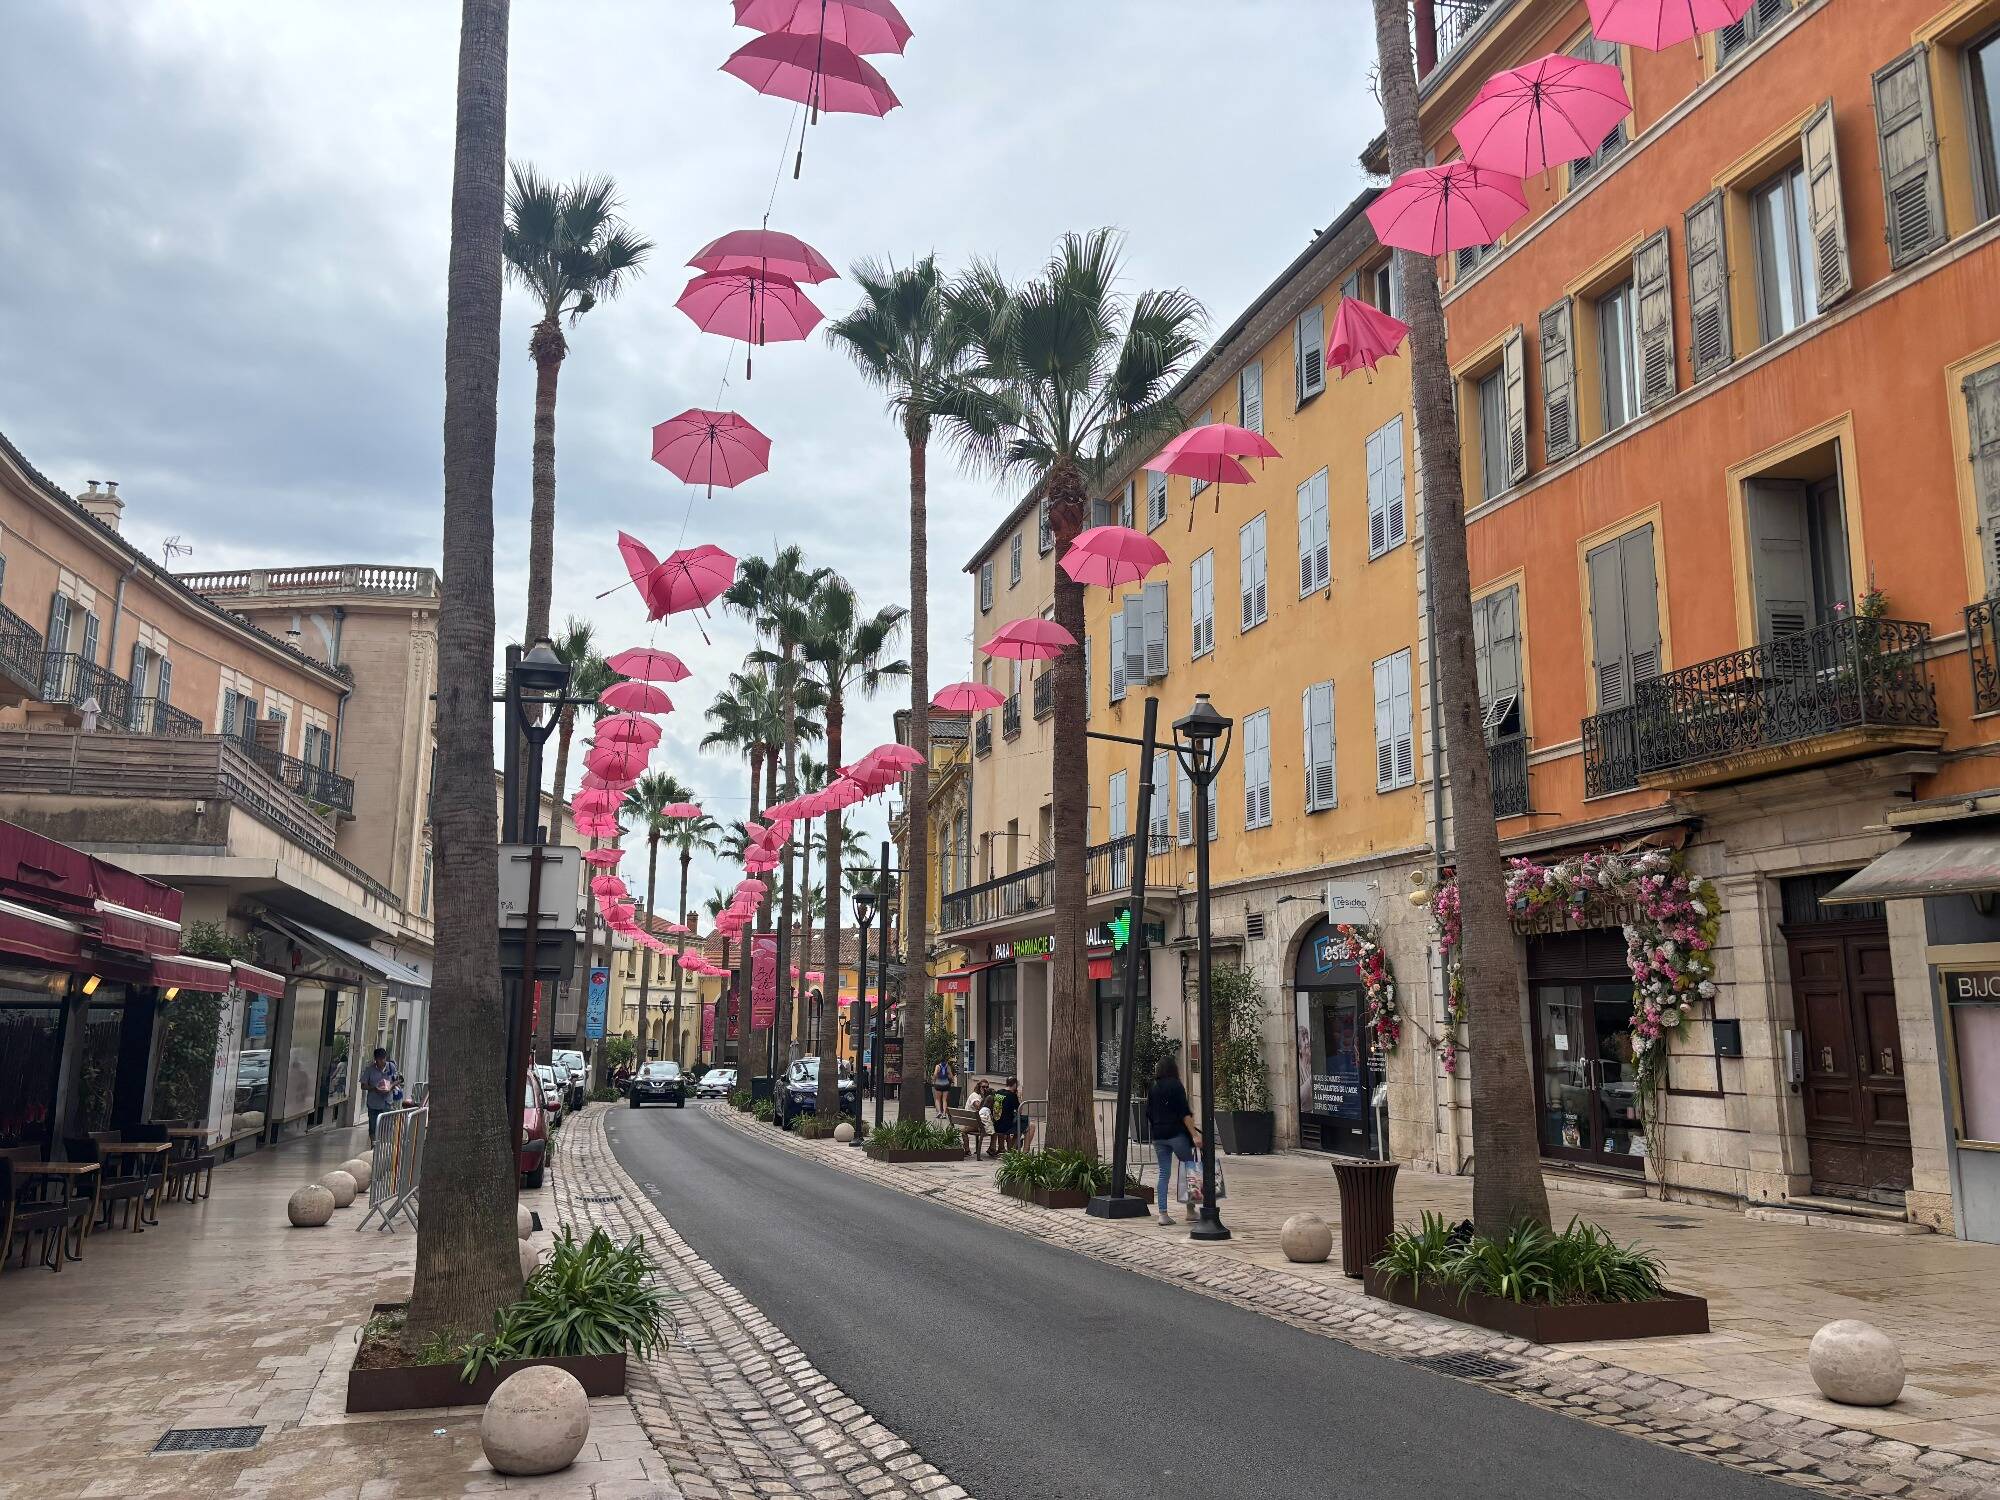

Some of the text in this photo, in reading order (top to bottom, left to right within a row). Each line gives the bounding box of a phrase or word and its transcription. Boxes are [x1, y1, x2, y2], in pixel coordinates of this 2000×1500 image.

[995, 942, 1010, 959] PARA
[1014, 935, 1048, 956] PHARMACIE
[1323, 1094, 1343, 1103] PERSONNE
